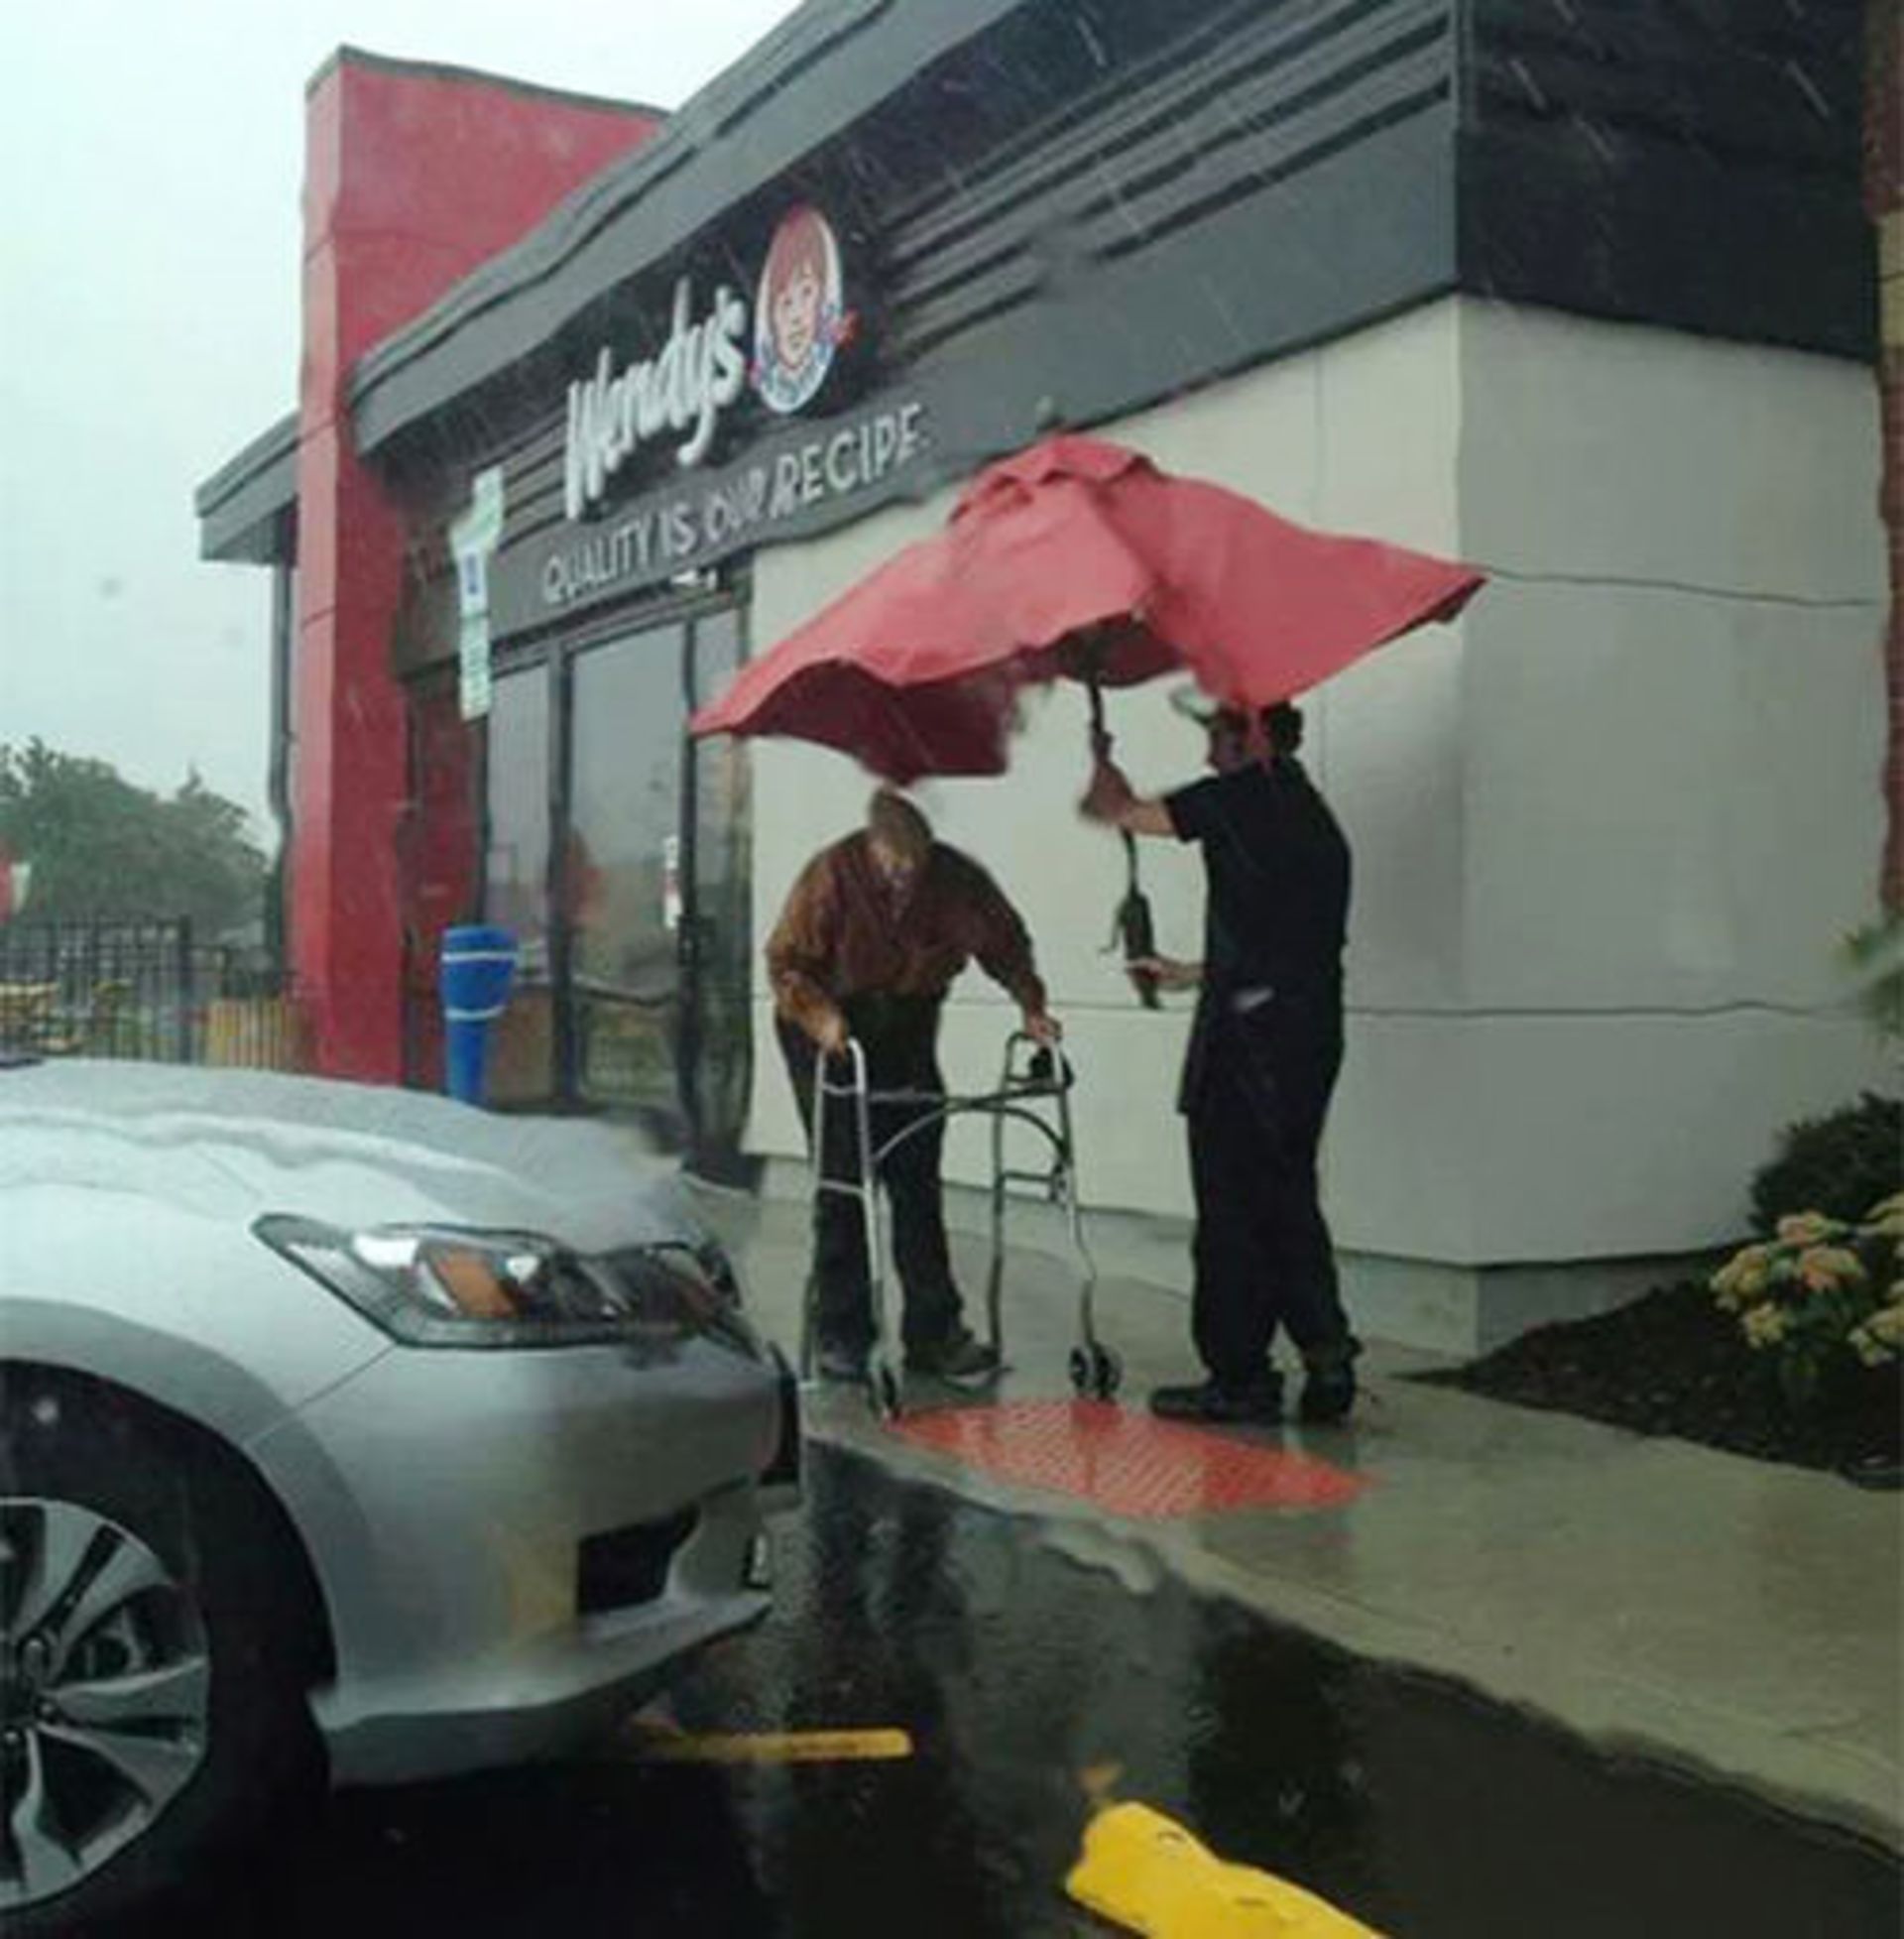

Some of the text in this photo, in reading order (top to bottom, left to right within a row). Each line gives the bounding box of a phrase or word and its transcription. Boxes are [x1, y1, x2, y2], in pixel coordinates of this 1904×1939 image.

[543, 402, 922, 603] QUALITY IS OUR RECIPE
[565, 277, 746, 520] Wendy's
